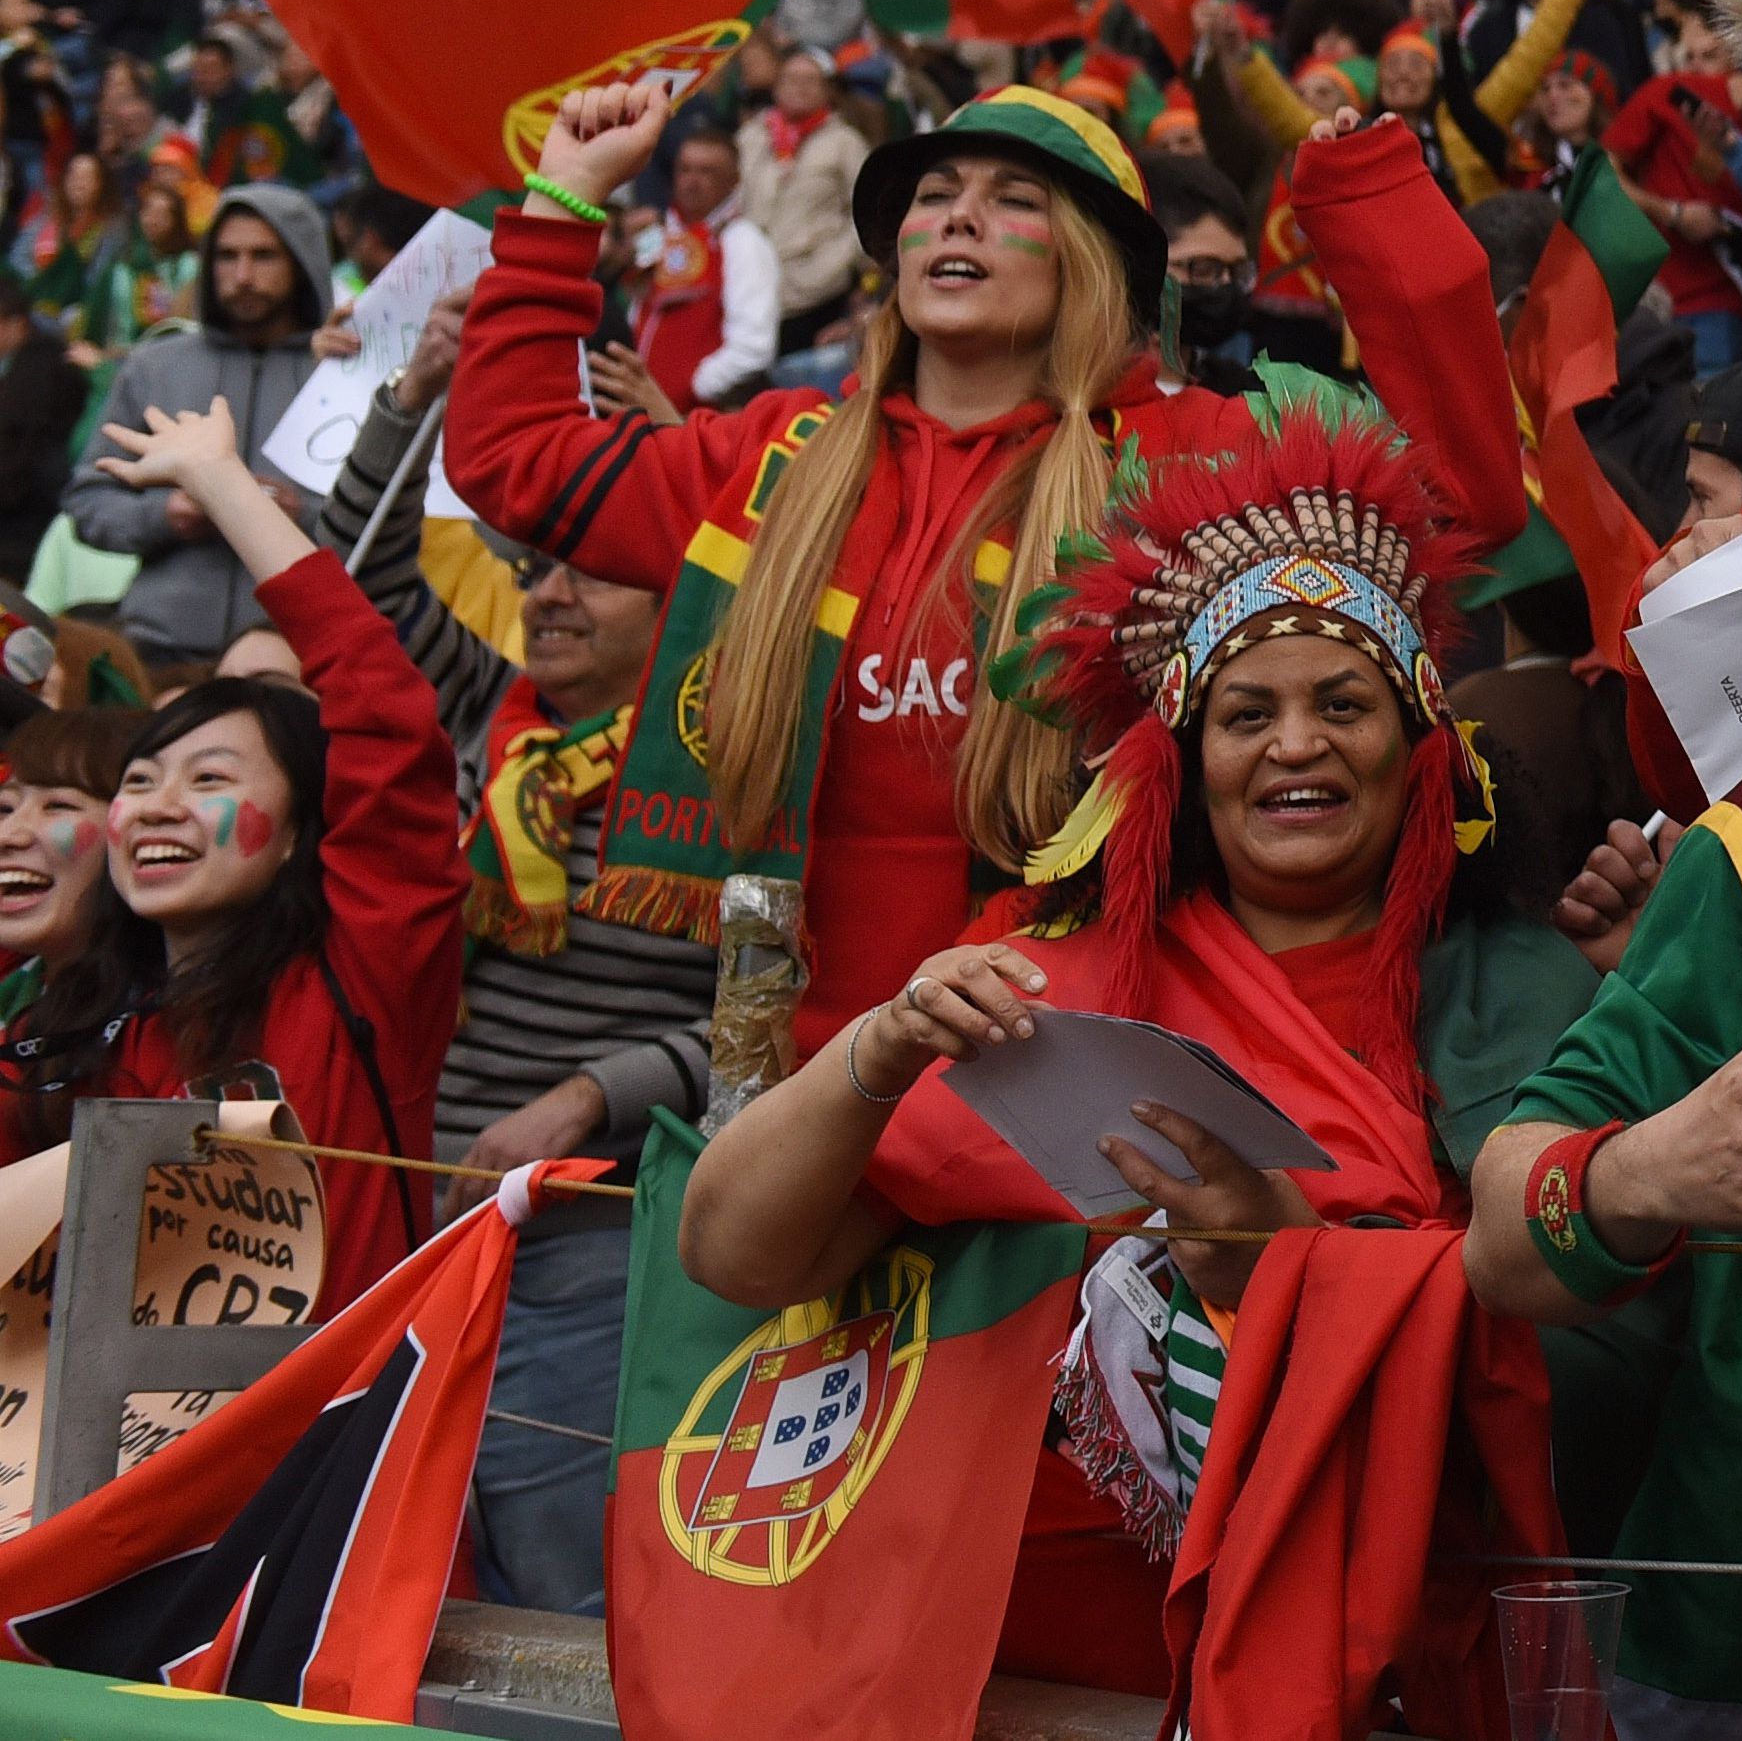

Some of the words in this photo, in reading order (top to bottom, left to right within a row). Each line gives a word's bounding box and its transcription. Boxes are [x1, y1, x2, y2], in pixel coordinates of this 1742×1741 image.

[857, 653, 968, 723] SAC
[615, 788, 802, 855] PORTAL
[150, 1205, 189, 1243] por
[207, 1223, 298, 1272] causa
